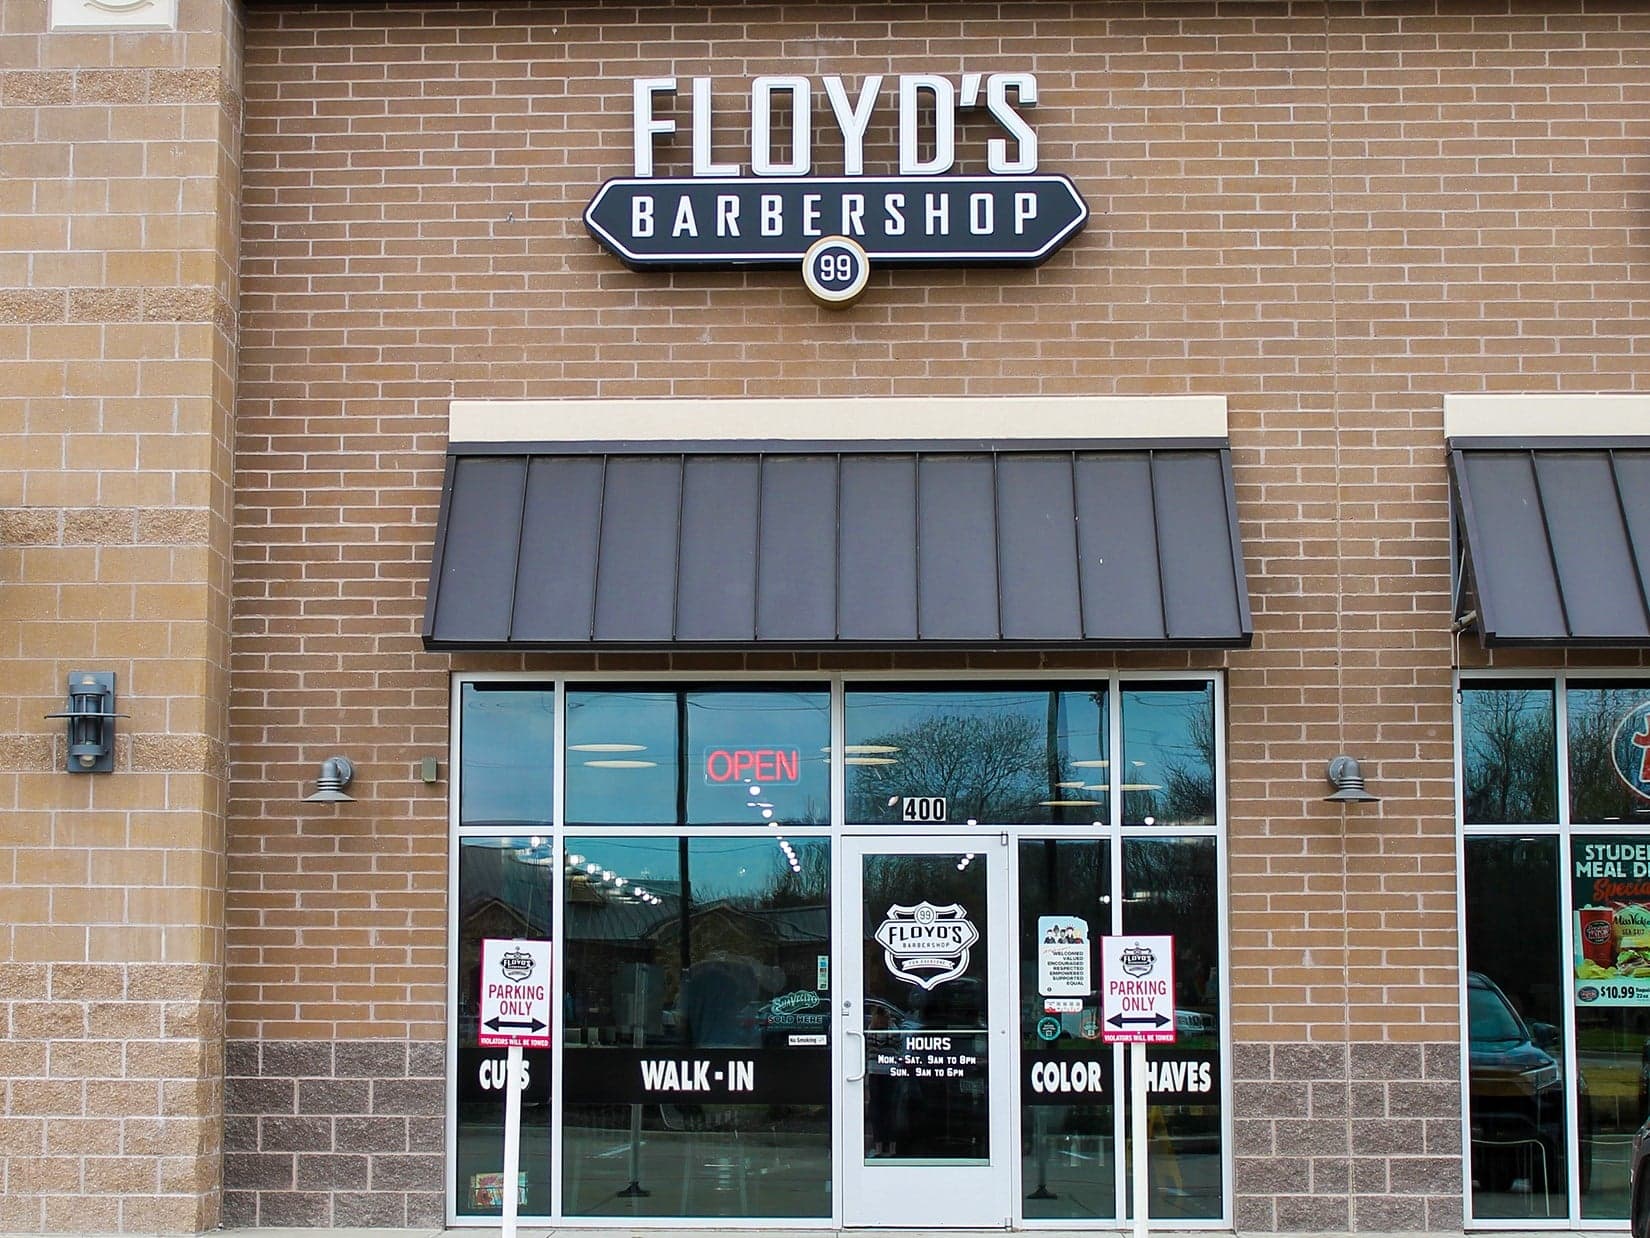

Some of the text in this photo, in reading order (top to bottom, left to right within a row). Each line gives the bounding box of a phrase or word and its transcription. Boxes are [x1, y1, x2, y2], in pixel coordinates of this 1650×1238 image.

[633, 73, 1038, 178] FLOYD'S
[631, 192, 1038, 238] BARBERSHOP
[820, 254, 852, 282] 99
[707, 749, 798, 782] OPEN
[904, 798, 945, 821] 400
[1575, 861, 1650, 878] MEAL D
[919, 910, 931, 920] 99
[888, 926, 962, 945] FLOYD'S
[488, 984, 544, 1000] PARKING
[1110, 980, 1167, 995] PARKING
[1600, 986, 1635, 999] $10.99
[500, 1000, 533, 1016] ONLY
[1122, 996, 1155, 1011] ONLY
[768, 1015, 822, 1024] SOLD HERE
[480, 1037, 508, 1045] VIOLATORS
[508, 1038, 521, 1046] WILL
[906, 1037, 951, 1050] HOURS
[479, 1059, 530, 1090] CUS
[1031, 1061, 1103, 1092] COLOR
